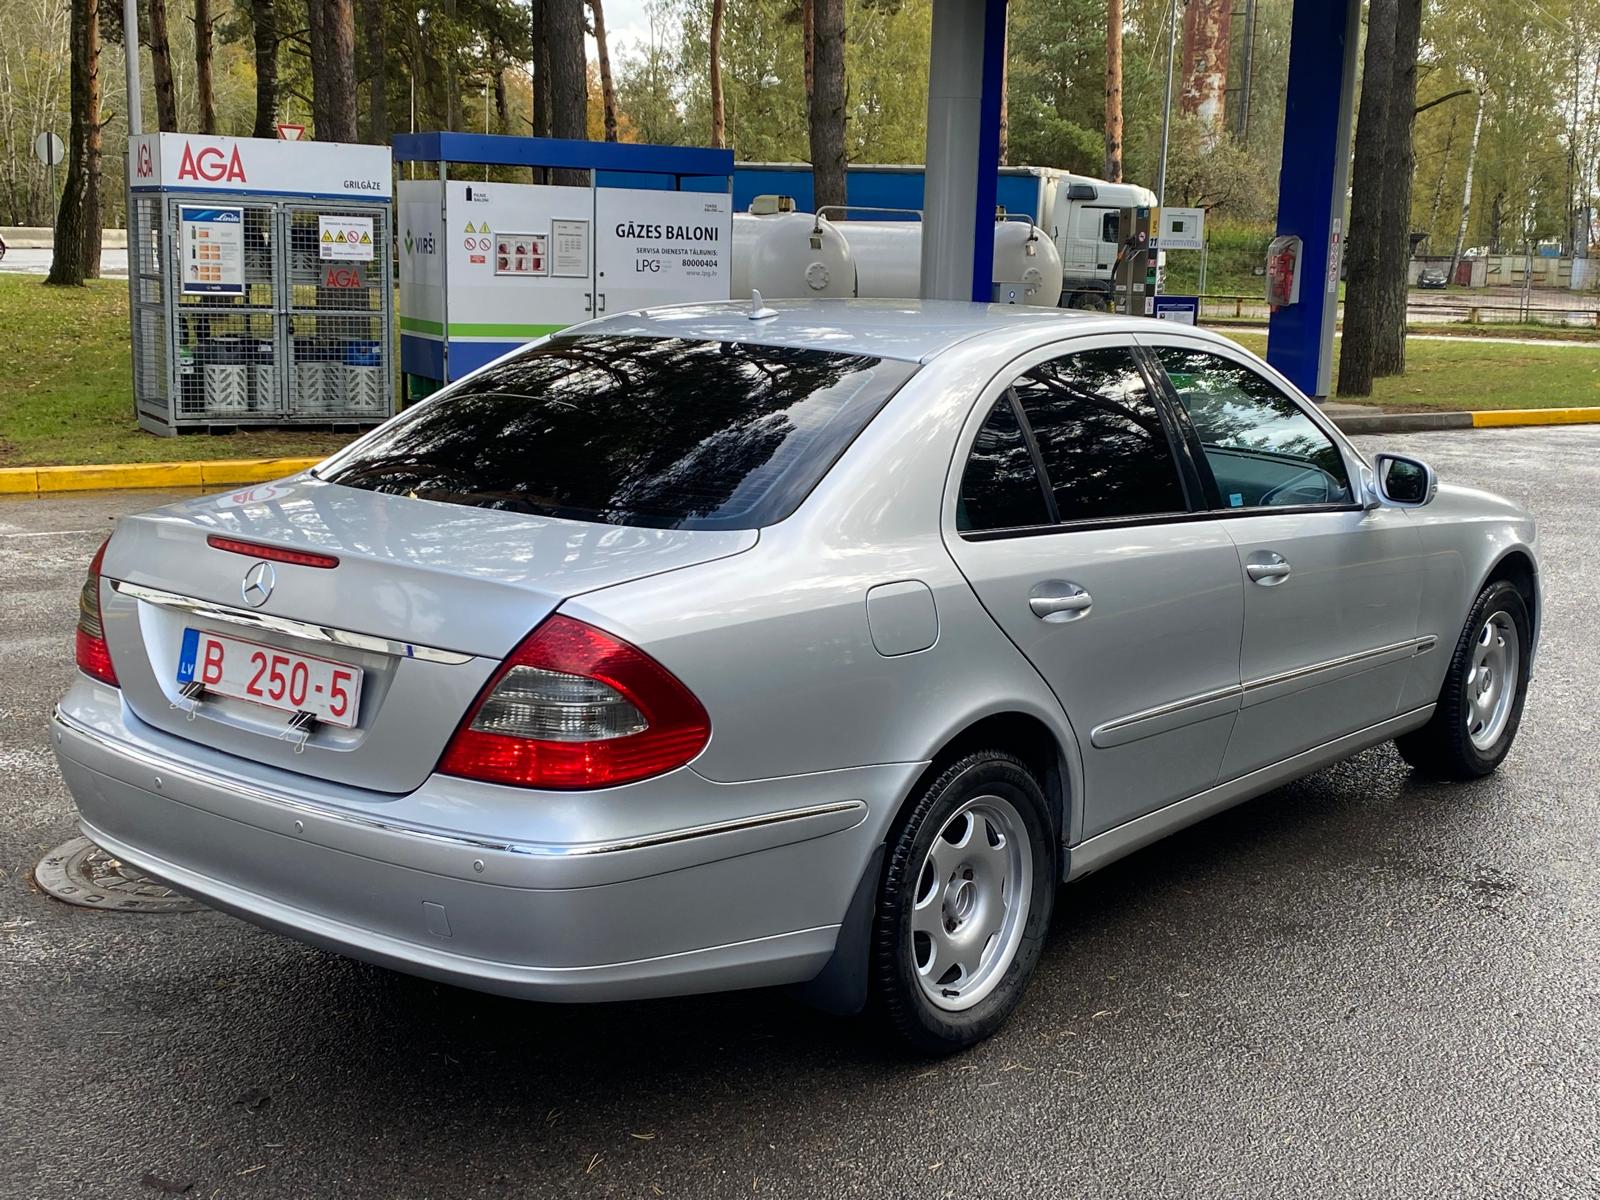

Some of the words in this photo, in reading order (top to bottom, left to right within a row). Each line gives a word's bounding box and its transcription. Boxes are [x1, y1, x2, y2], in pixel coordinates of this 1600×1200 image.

[137, 140, 153, 177] AGA
[177, 140, 247, 182] AGA
[343, 180, 382, 190] GRILGĀZE
[615, 220, 662, 240] GĀZES
[665, 225, 719, 241] BALONI
[415, 232, 436, 254] VIRŠI
[636, 259, 661, 272] LPG
[681, 258, 718, 267] 80000404
[325, 266, 361, 287] AGA
[181, 662, 194, 675] LV
[202, 639, 225, 685] B
[246, 651, 352, 717] 250-5
